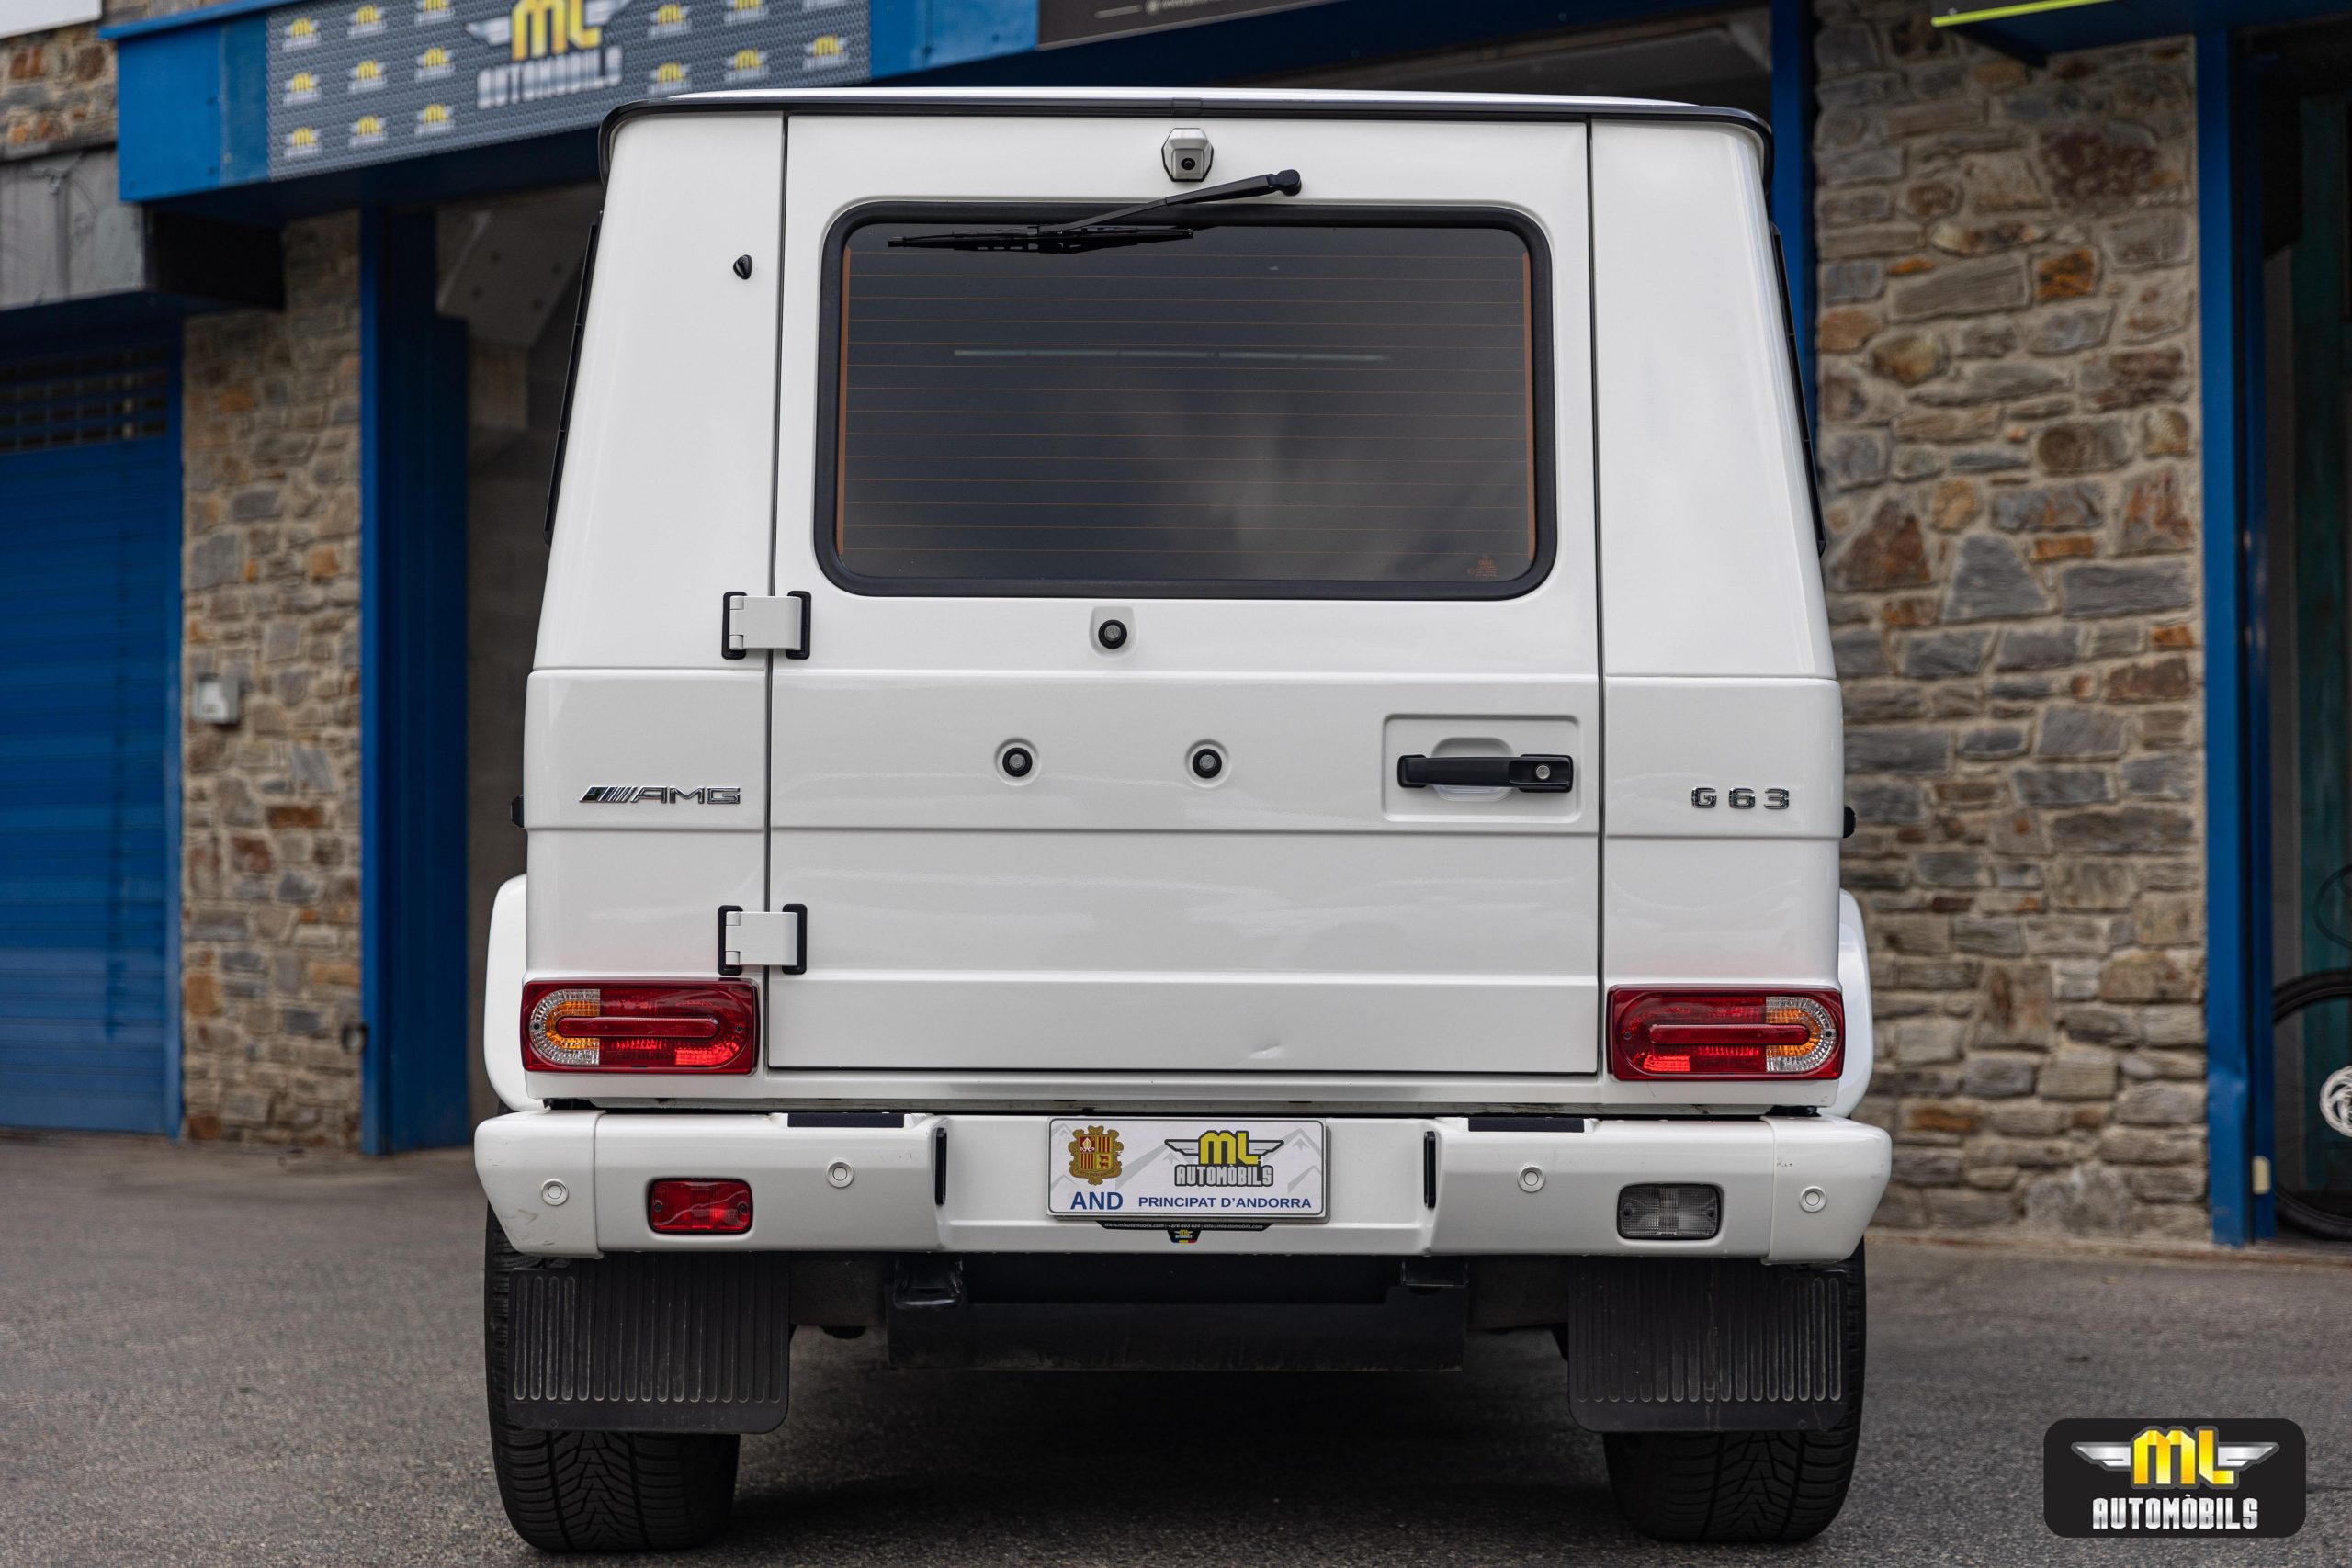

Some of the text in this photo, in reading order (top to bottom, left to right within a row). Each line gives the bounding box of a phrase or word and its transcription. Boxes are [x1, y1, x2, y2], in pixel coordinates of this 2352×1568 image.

[512, 0, 602, 62] ML
[630, 785, 741, 804] AMG
[1199, 1132, 1259, 1165] ML
[1070, 1191, 1124, 1210] AND
[1138, 1197, 1216, 1208] PRINCIPAT
